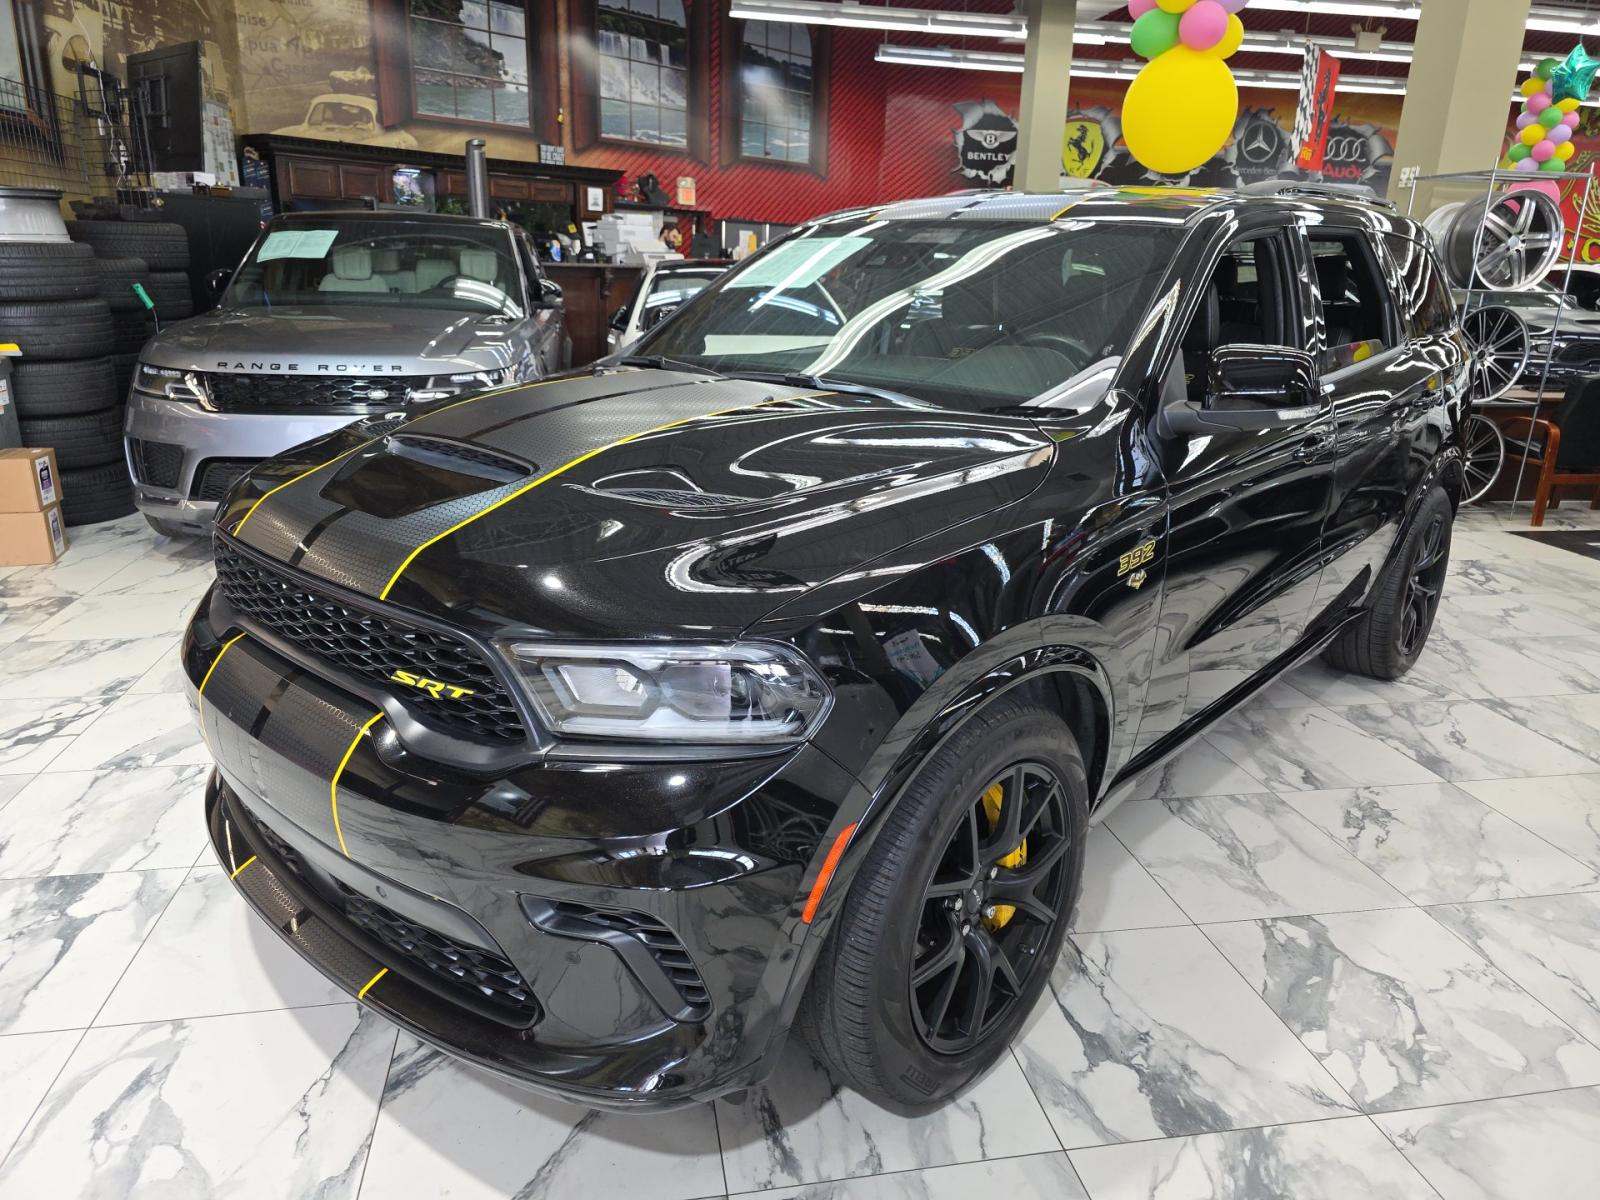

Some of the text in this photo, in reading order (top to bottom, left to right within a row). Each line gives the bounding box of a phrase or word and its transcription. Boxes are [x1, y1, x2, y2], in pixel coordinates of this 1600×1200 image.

[967, 151, 1009, 161] BENTLEY
[217, 361, 299, 371] RANGE
[1117, 540, 1156, 577] 392
[391, 670, 475, 699] SRT
